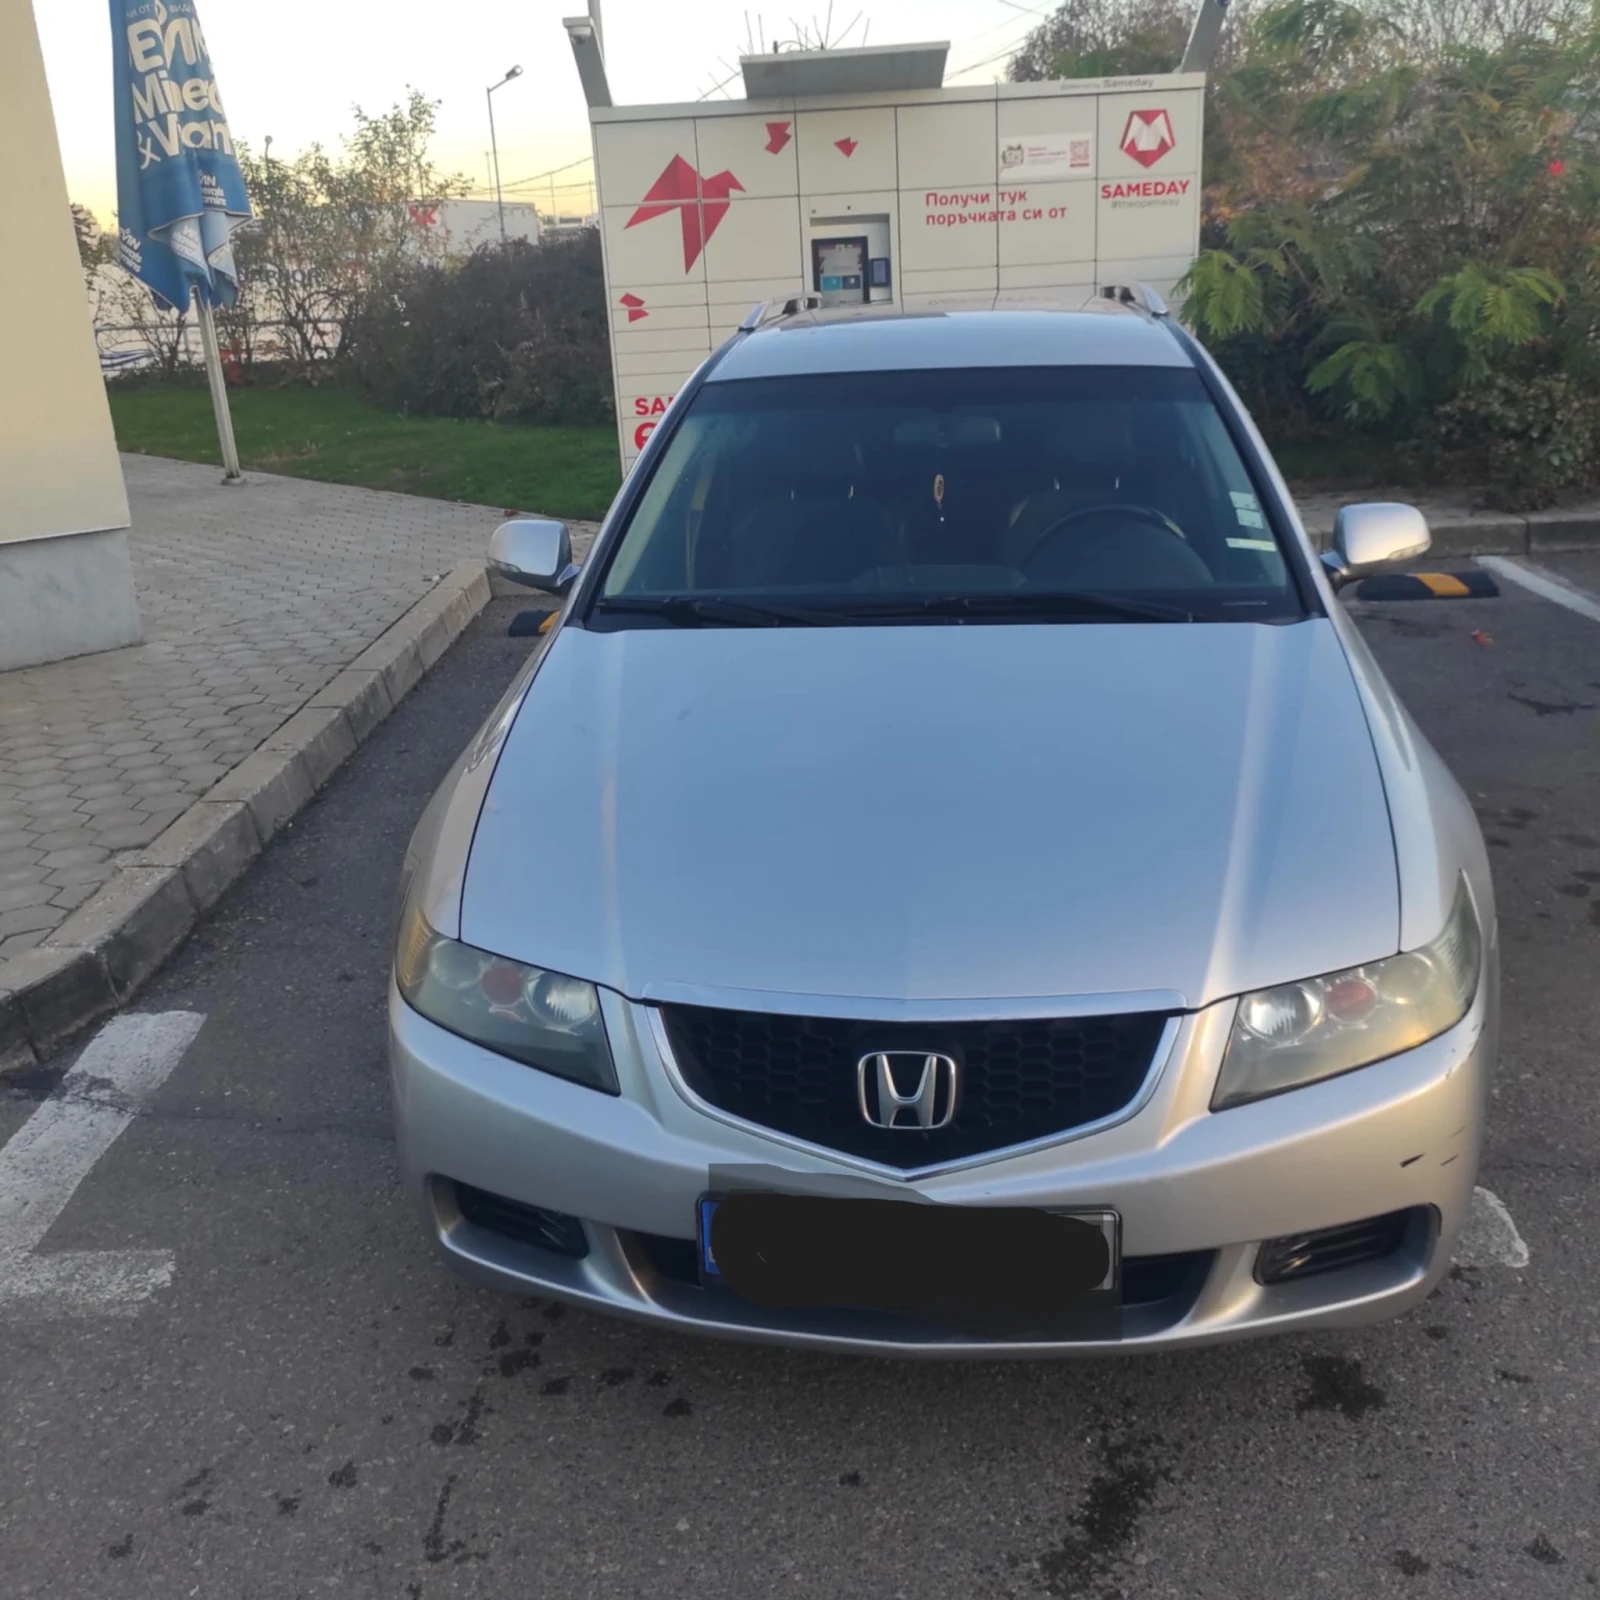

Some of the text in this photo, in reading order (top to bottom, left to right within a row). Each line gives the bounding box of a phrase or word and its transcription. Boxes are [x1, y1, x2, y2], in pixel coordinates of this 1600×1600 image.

[1103, 77, 1154, 89] Sameday
[1101, 179, 1190, 199] SAMEDAY
[925, 190, 1028, 207] Получи тук
[926, 206, 1068, 227] поръчката си от
